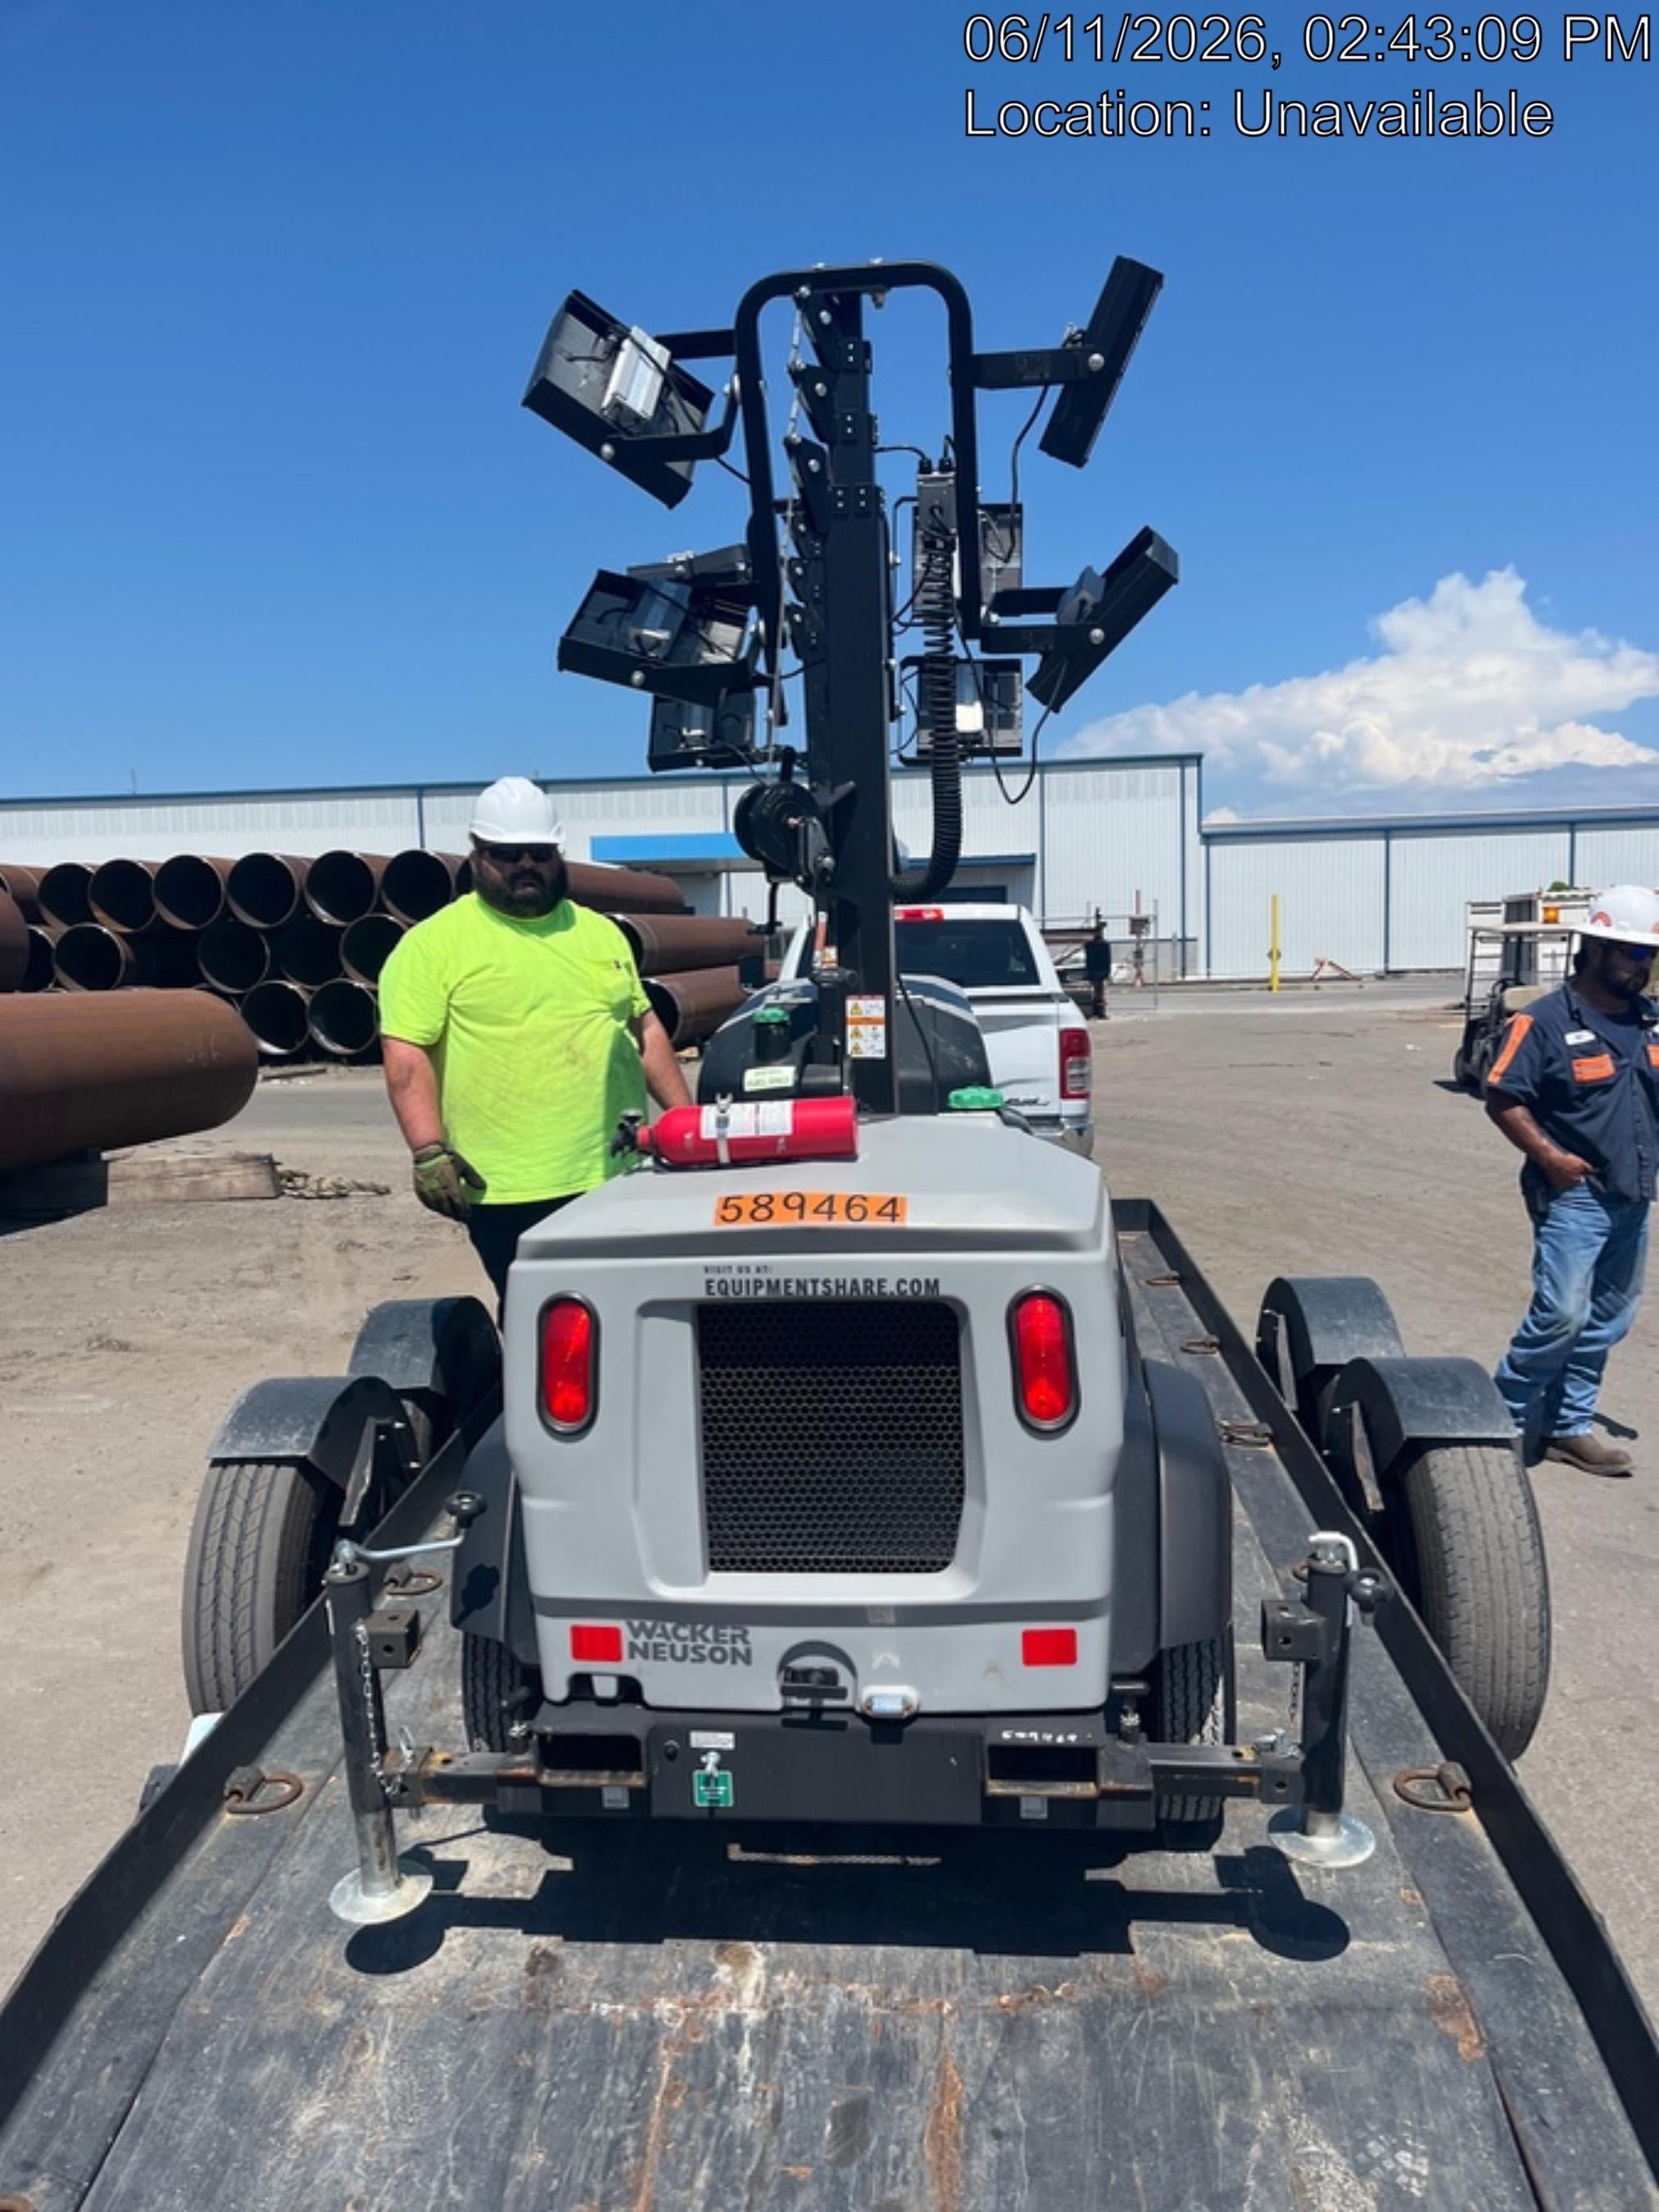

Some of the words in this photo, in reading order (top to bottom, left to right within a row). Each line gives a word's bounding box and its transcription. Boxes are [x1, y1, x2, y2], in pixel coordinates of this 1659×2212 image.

[719, 1191, 901, 1222] 589464
[705, 1278, 941, 1297] EQUIPMENTSHARE.COM
[627, 1621, 751, 1645] WACKER
[628, 1641, 752, 1666] NEUSON
